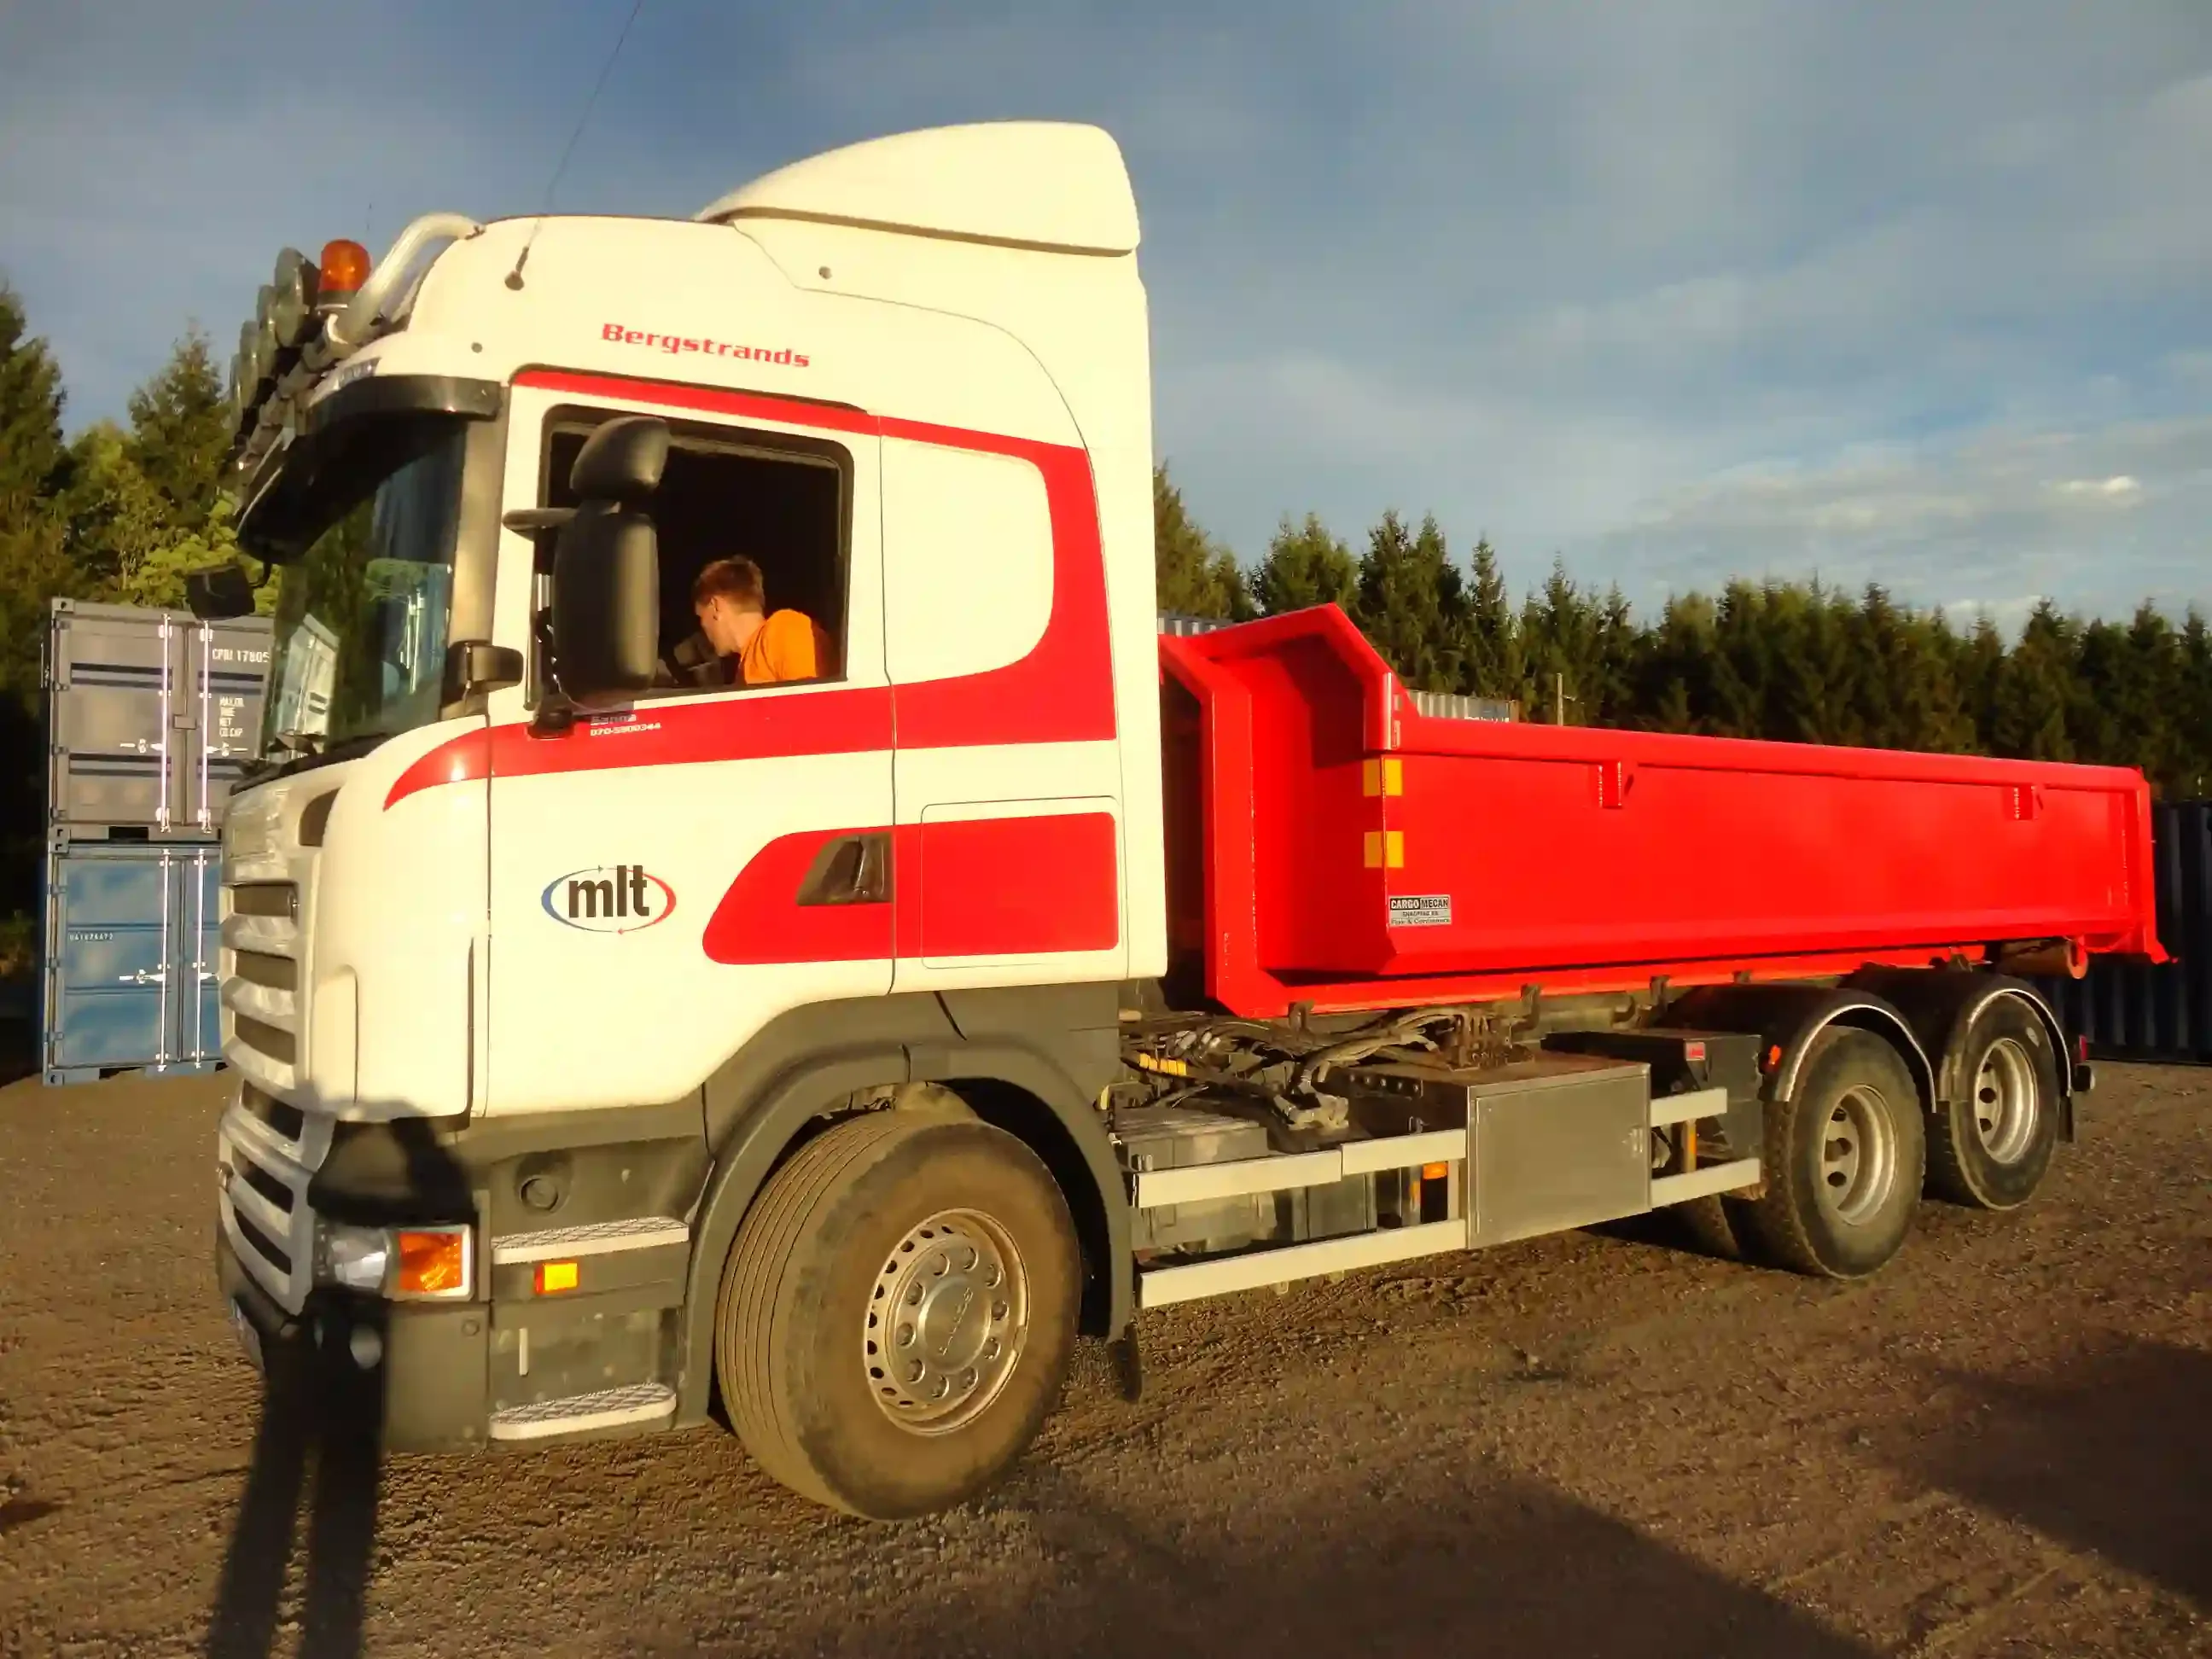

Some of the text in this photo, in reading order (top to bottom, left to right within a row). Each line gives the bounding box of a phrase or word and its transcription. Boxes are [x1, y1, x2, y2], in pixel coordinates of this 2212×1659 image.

[601, 323, 811, 368] Bergstrands
[568, 864, 649, 918] mlt
[1390, 899, 1448, 909] CARGO MECAN
